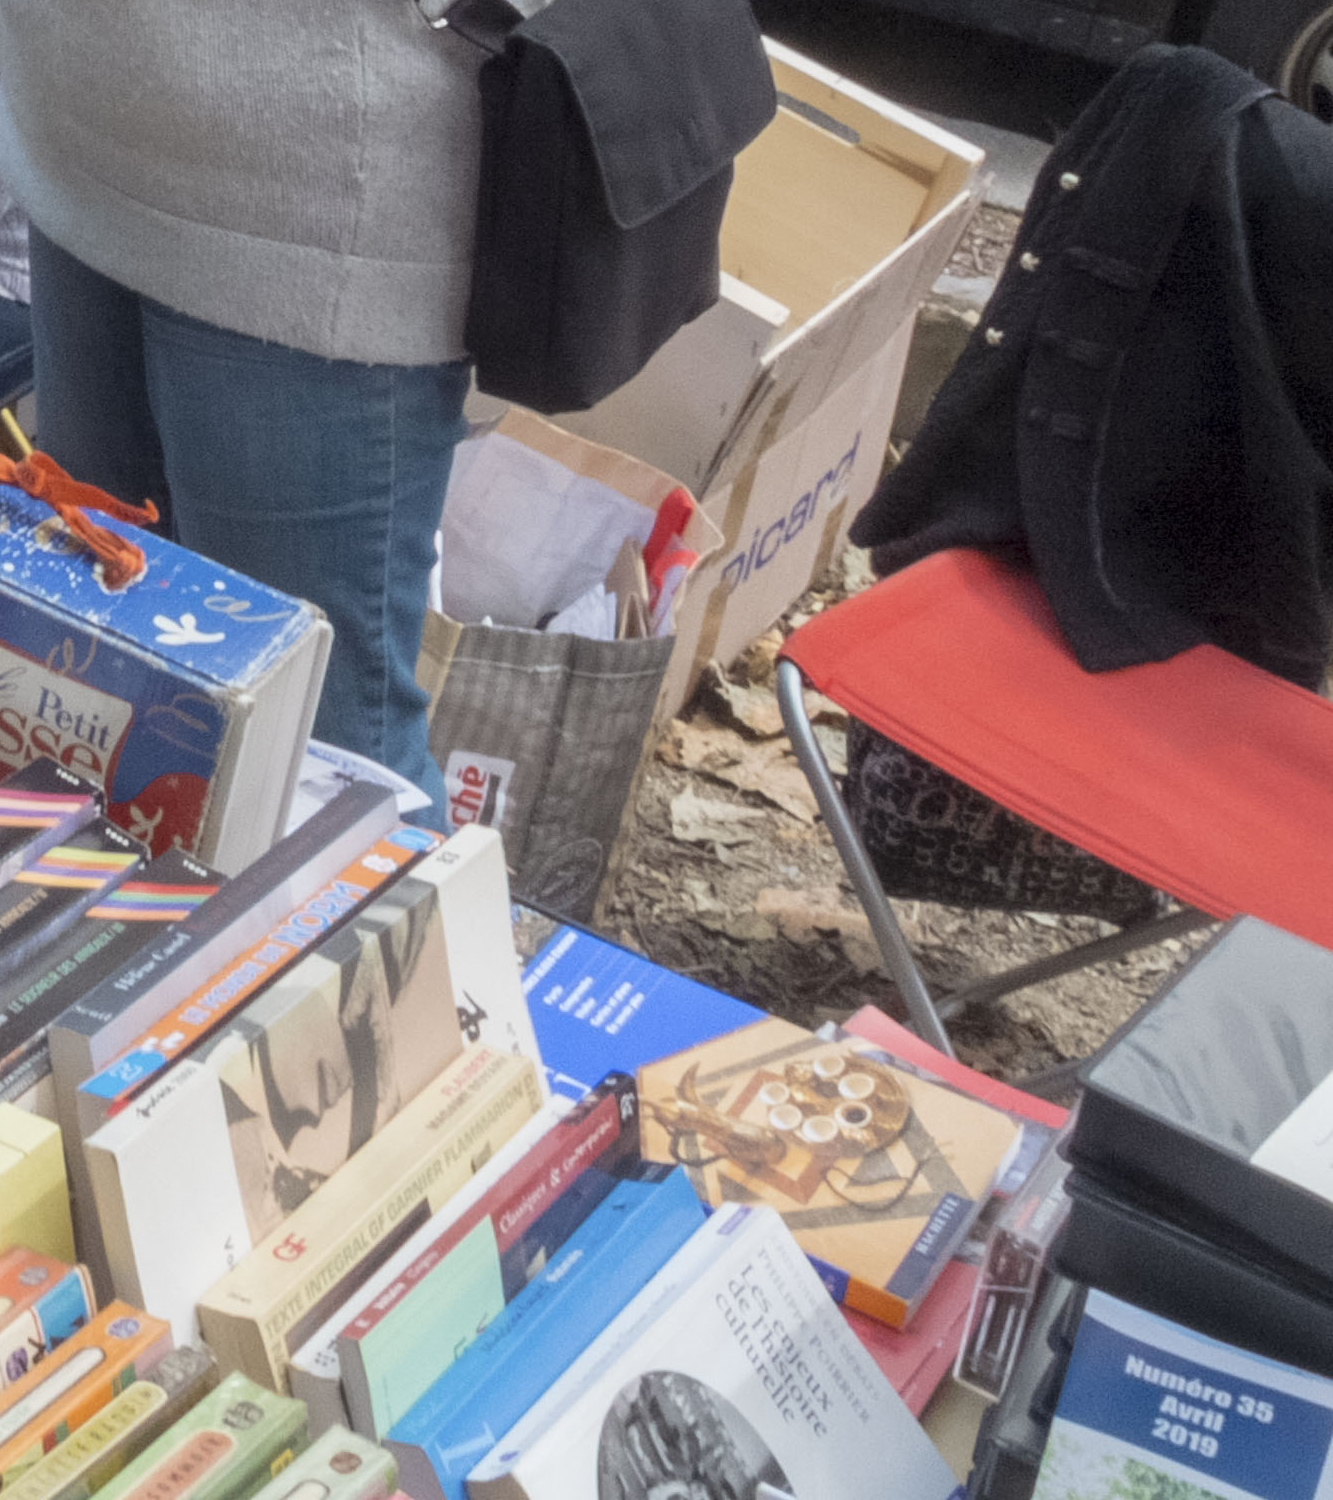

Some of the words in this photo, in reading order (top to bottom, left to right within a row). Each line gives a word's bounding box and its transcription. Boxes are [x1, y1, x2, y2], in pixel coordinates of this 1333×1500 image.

[35, 686, 110, 752] Petit
[272, 1233, 309, 1263] GF
[264, 1290, 308, 1337] TEXTE
[739, 1262, 772, 1315] Les
[772, 1318, 834, 1413] enjeux
[714, 1291, 795, 1424] culturelle
[726, 1278, 752, 1313] de
[750, 1313, 828, 1439] l'histoire
[1125, 1356, 1235, 1410] Numéro
[1236, 1393, 1275, 1426] 35
[1158, 1395, 1226, 1435] Avril
[1150, 1420, 1220, 1459] 2019
